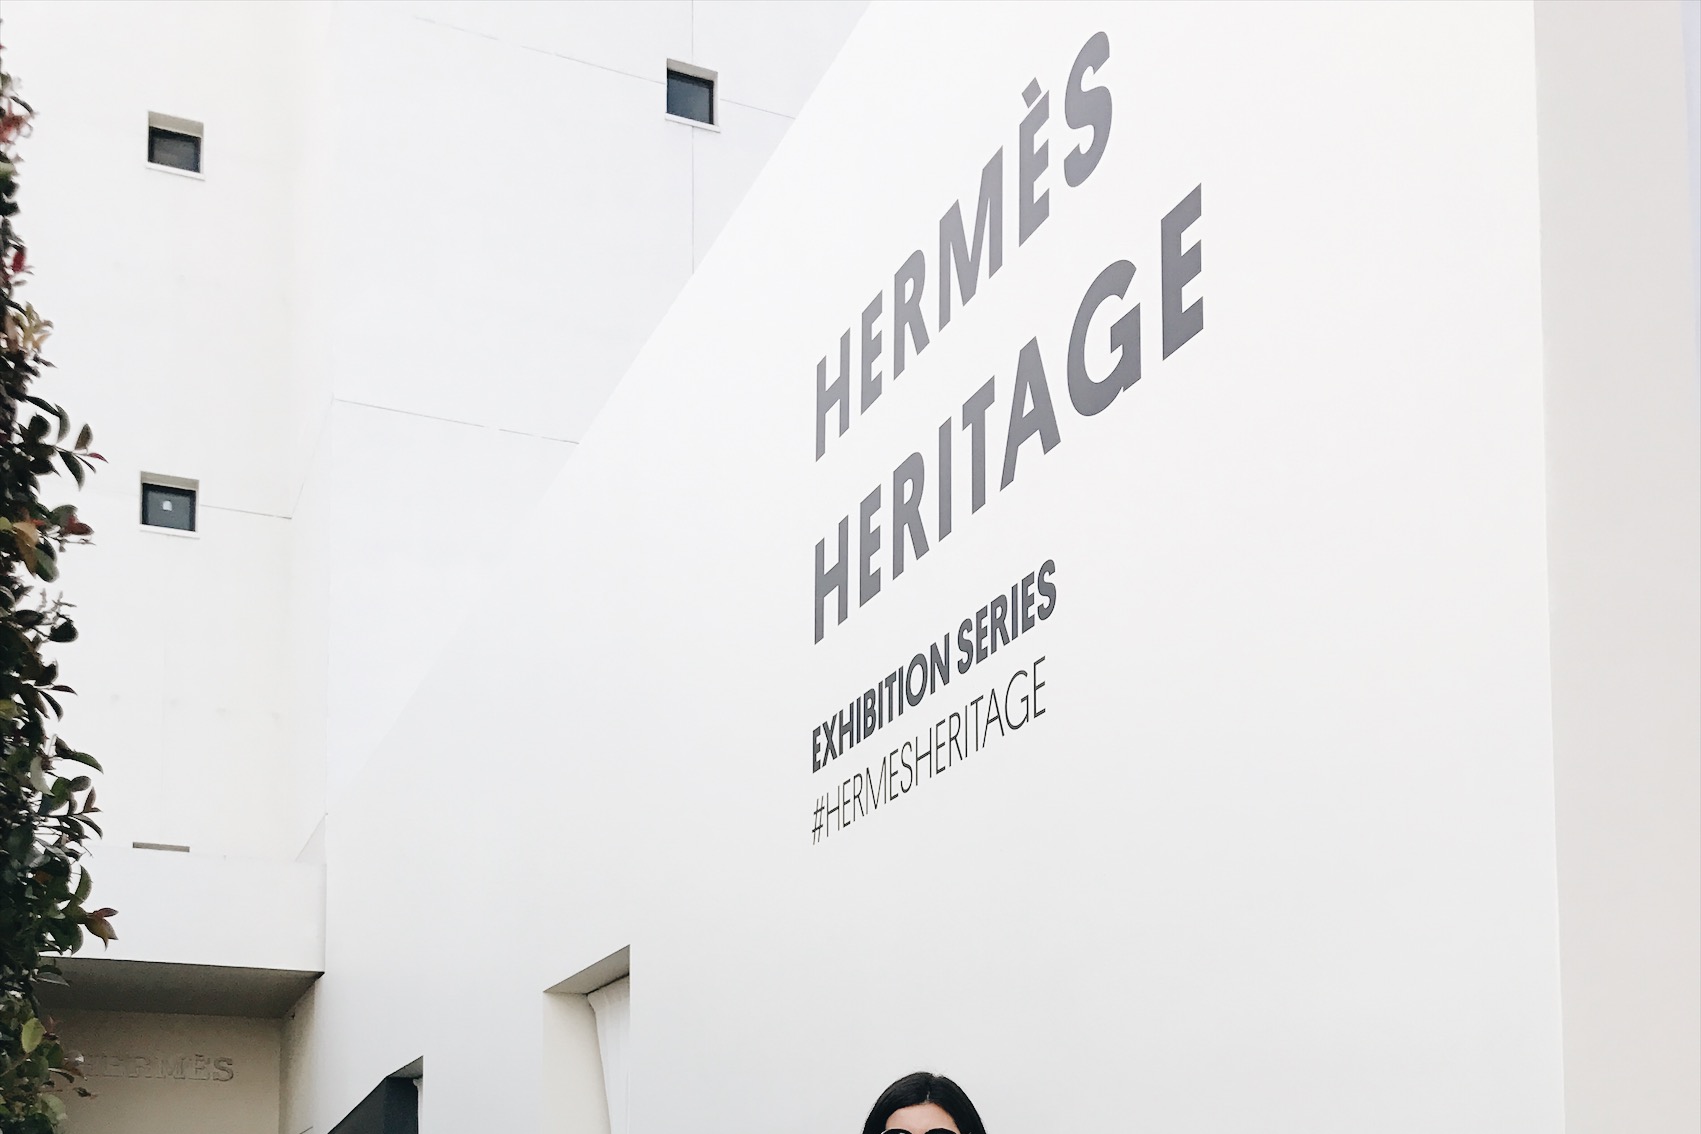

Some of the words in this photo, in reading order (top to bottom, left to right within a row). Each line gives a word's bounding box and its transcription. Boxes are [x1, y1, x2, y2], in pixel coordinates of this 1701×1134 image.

[815, 31, 1113, 462] HERMÈS
[813, 182, 1204, 646] HERITAGE
[811, 655, 1047, 846] #HERMESHERITAGE
[812, 631, 951, 775] EXHIBITION
[956, 558, 1057, 675] SERIES
